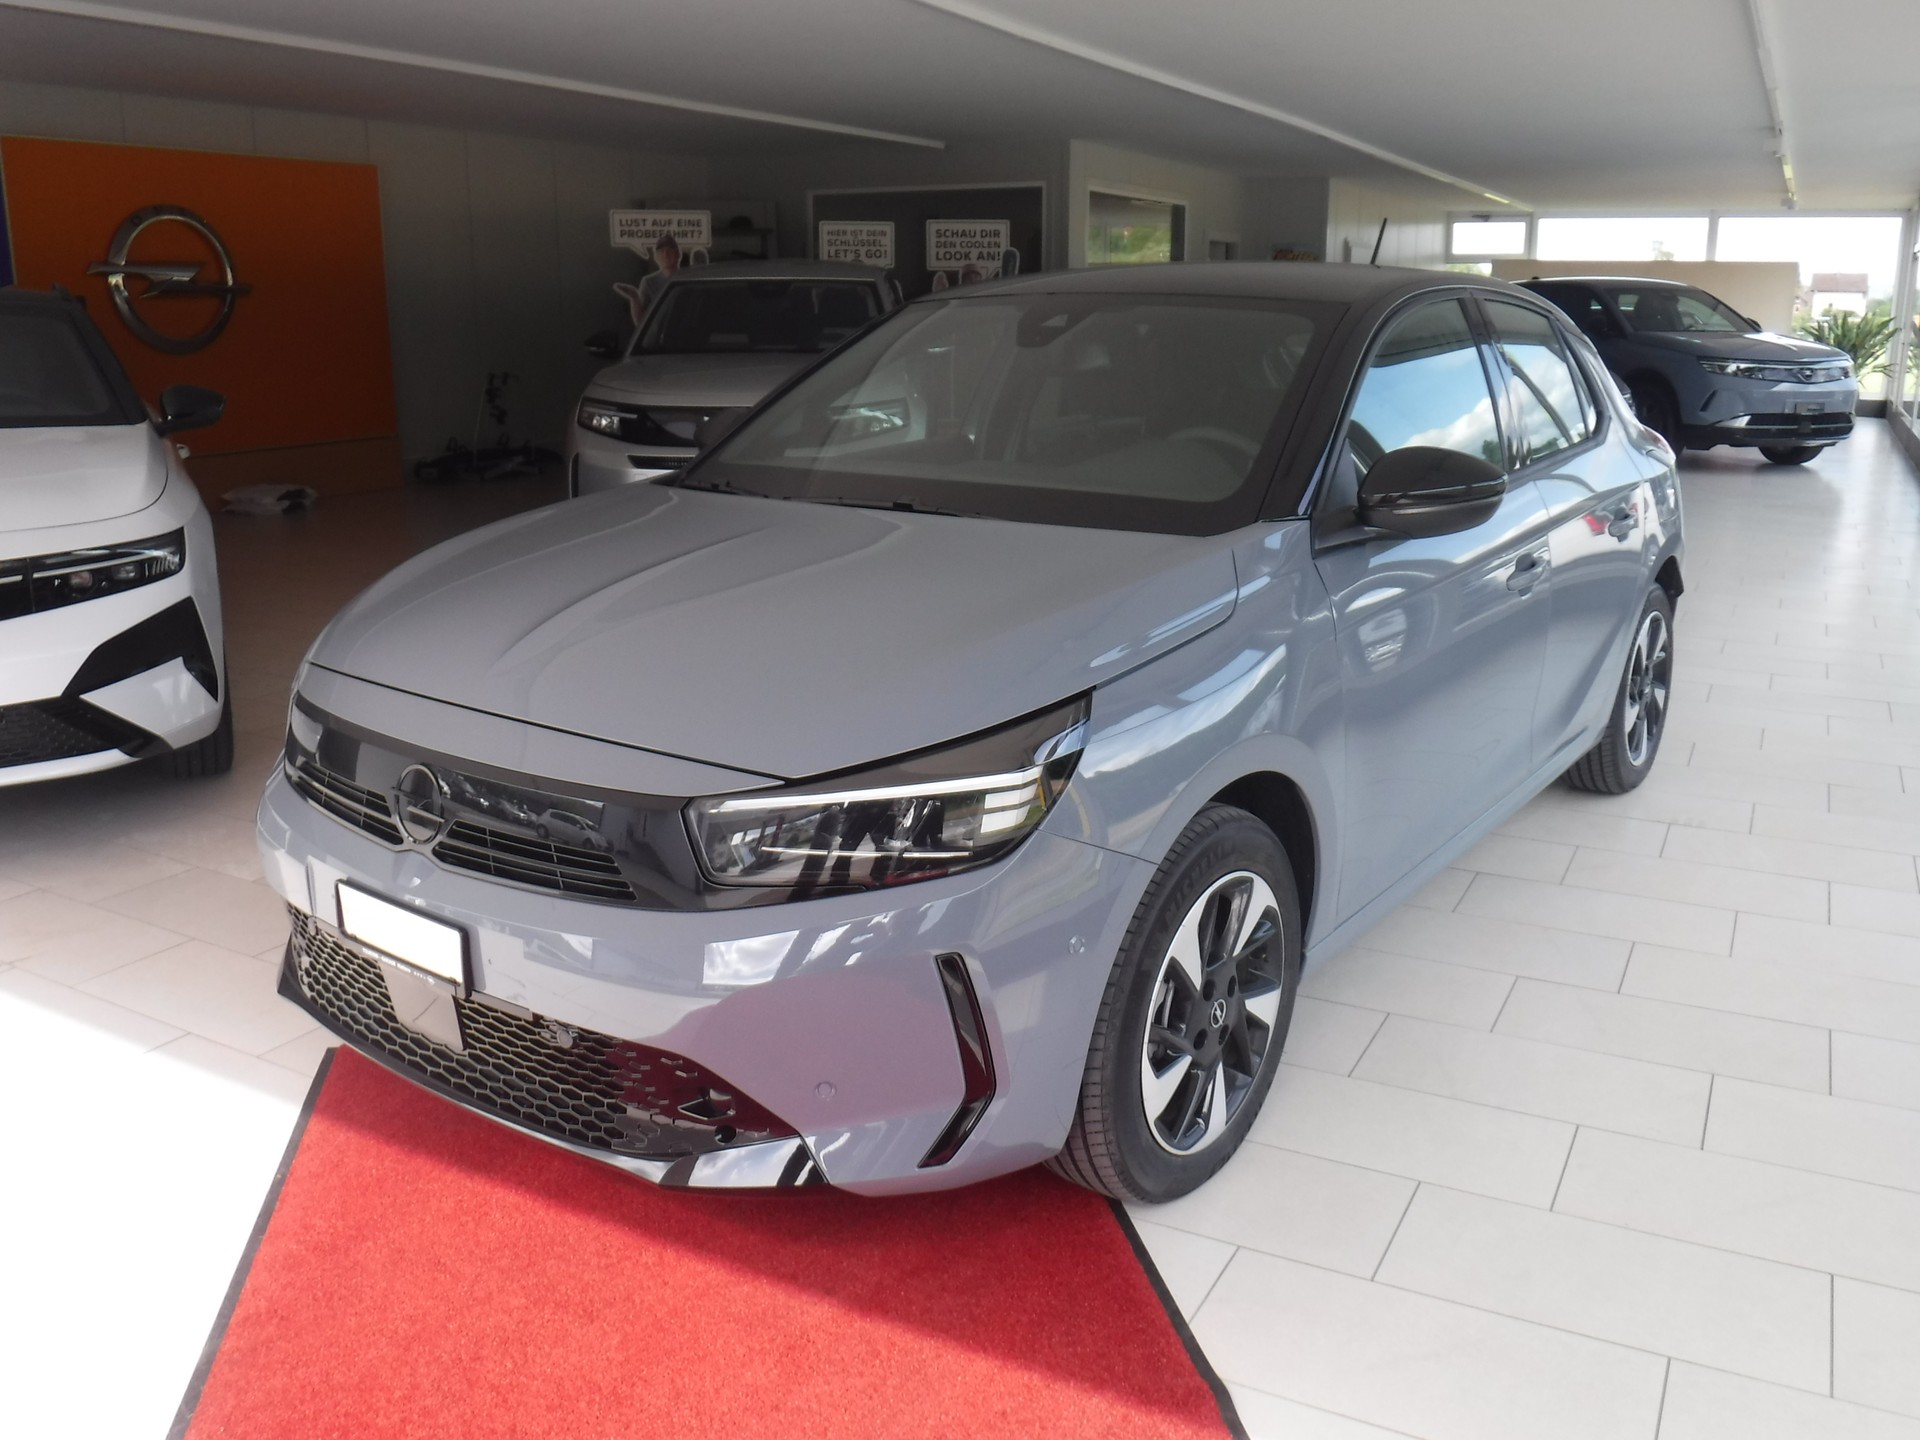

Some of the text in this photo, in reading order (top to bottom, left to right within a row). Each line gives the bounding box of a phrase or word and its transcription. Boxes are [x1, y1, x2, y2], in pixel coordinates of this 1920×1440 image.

[619, 218, 703, 227] LUST AUF EINE
[827, 229, 887, 237] HIER IST DEIN
[935, 228, 1001, 238] SCHAU DIR
[935, 240, 1001, 249] DEN COOLEN
[827, 249, 888, 259] LET'S GO!
[935, 250, 1001, 261] LOOK AN!
